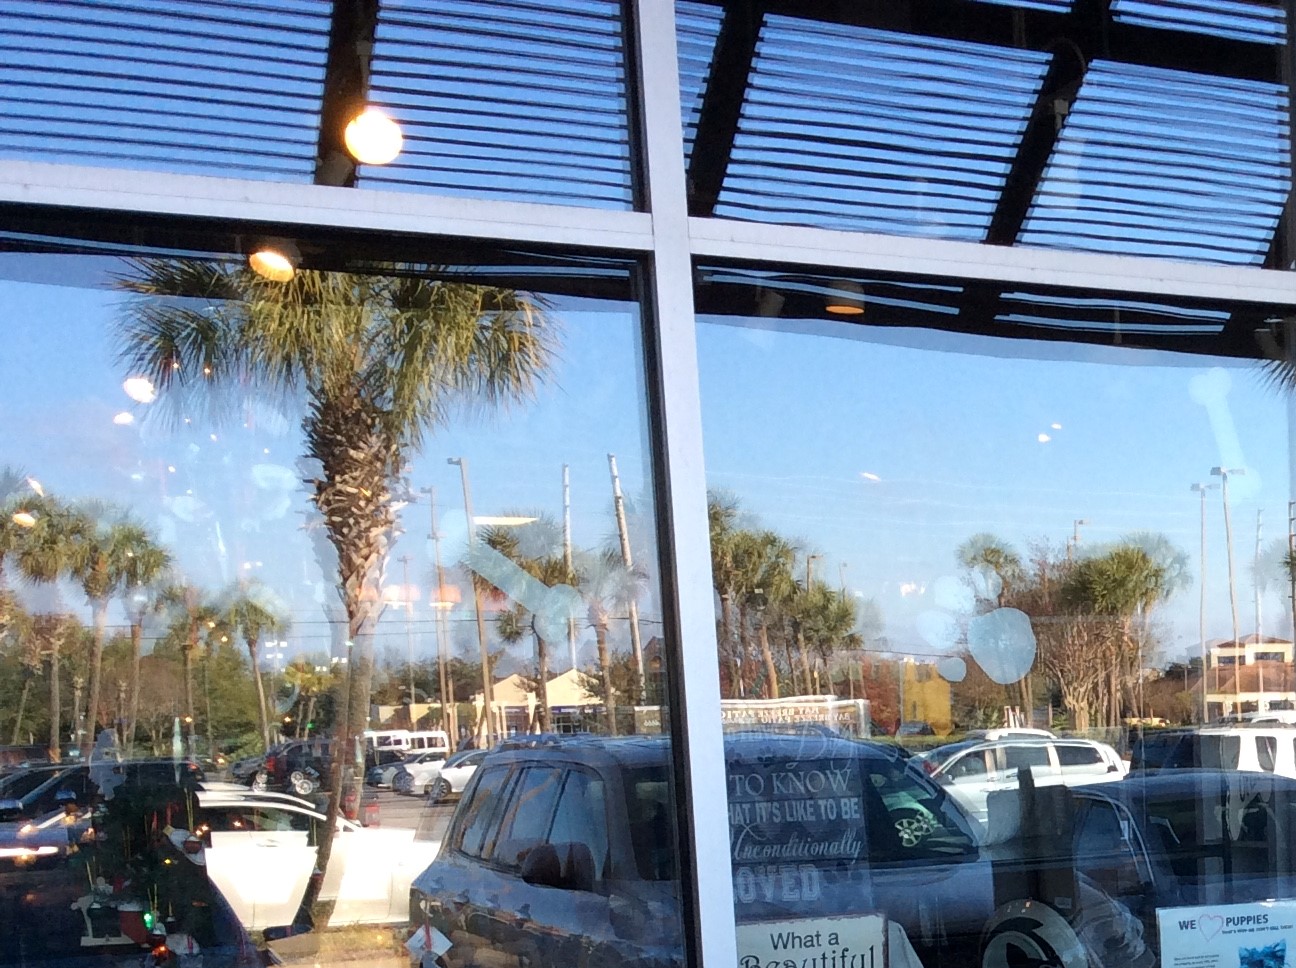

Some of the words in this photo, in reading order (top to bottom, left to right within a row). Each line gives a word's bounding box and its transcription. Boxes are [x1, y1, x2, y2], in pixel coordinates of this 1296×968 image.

[729, 773, 764, 796] TO
[772, 769, 852, 794] KNOW
[728, 802, 750, 825] HAT
[755, 802, 781, 824] IT'S
[785, 799, 816, 822] LIKE
[819, 799, 837, 821] TO
[841, 798, 860, 820] BE
[733, 864, 821, 904] OVED
[1178, 920, 1197, 931] WE
[1226, 914, 1269, 927] PUPPIES
[770, 931, 822, 951] What
[828, 932, 839, 946] a
